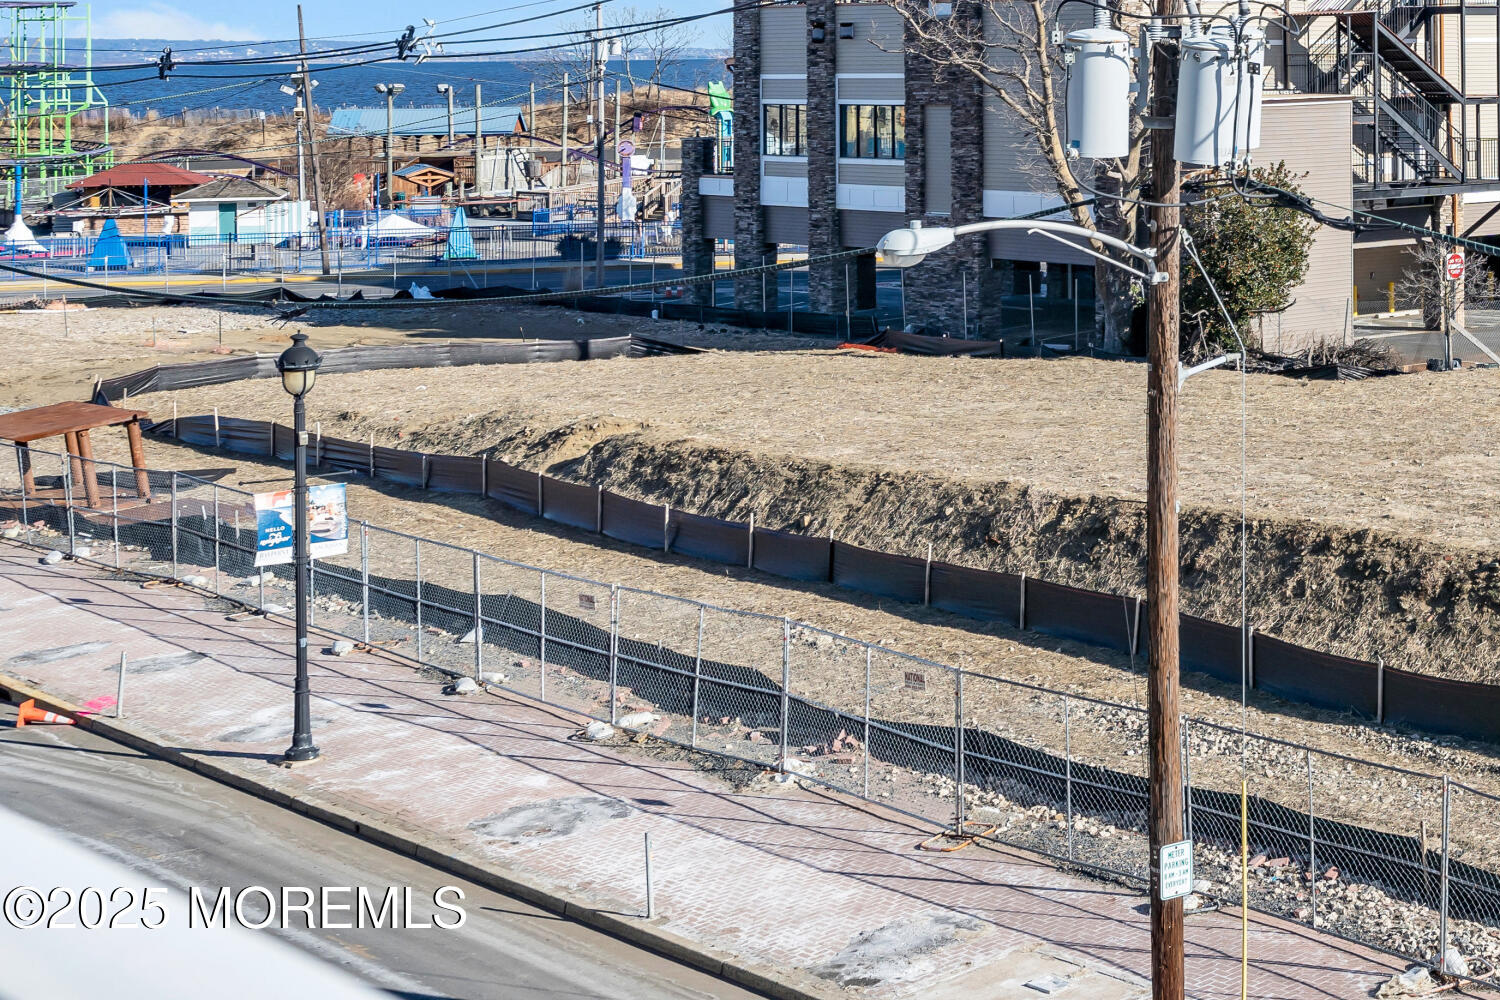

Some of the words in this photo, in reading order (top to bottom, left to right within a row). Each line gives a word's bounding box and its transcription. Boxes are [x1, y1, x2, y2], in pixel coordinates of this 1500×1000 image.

[264, 525, 286, 534] HELLO
[1167, 848, 1185, 860] METER
[1164, 858, 1189, 871] PARKING
